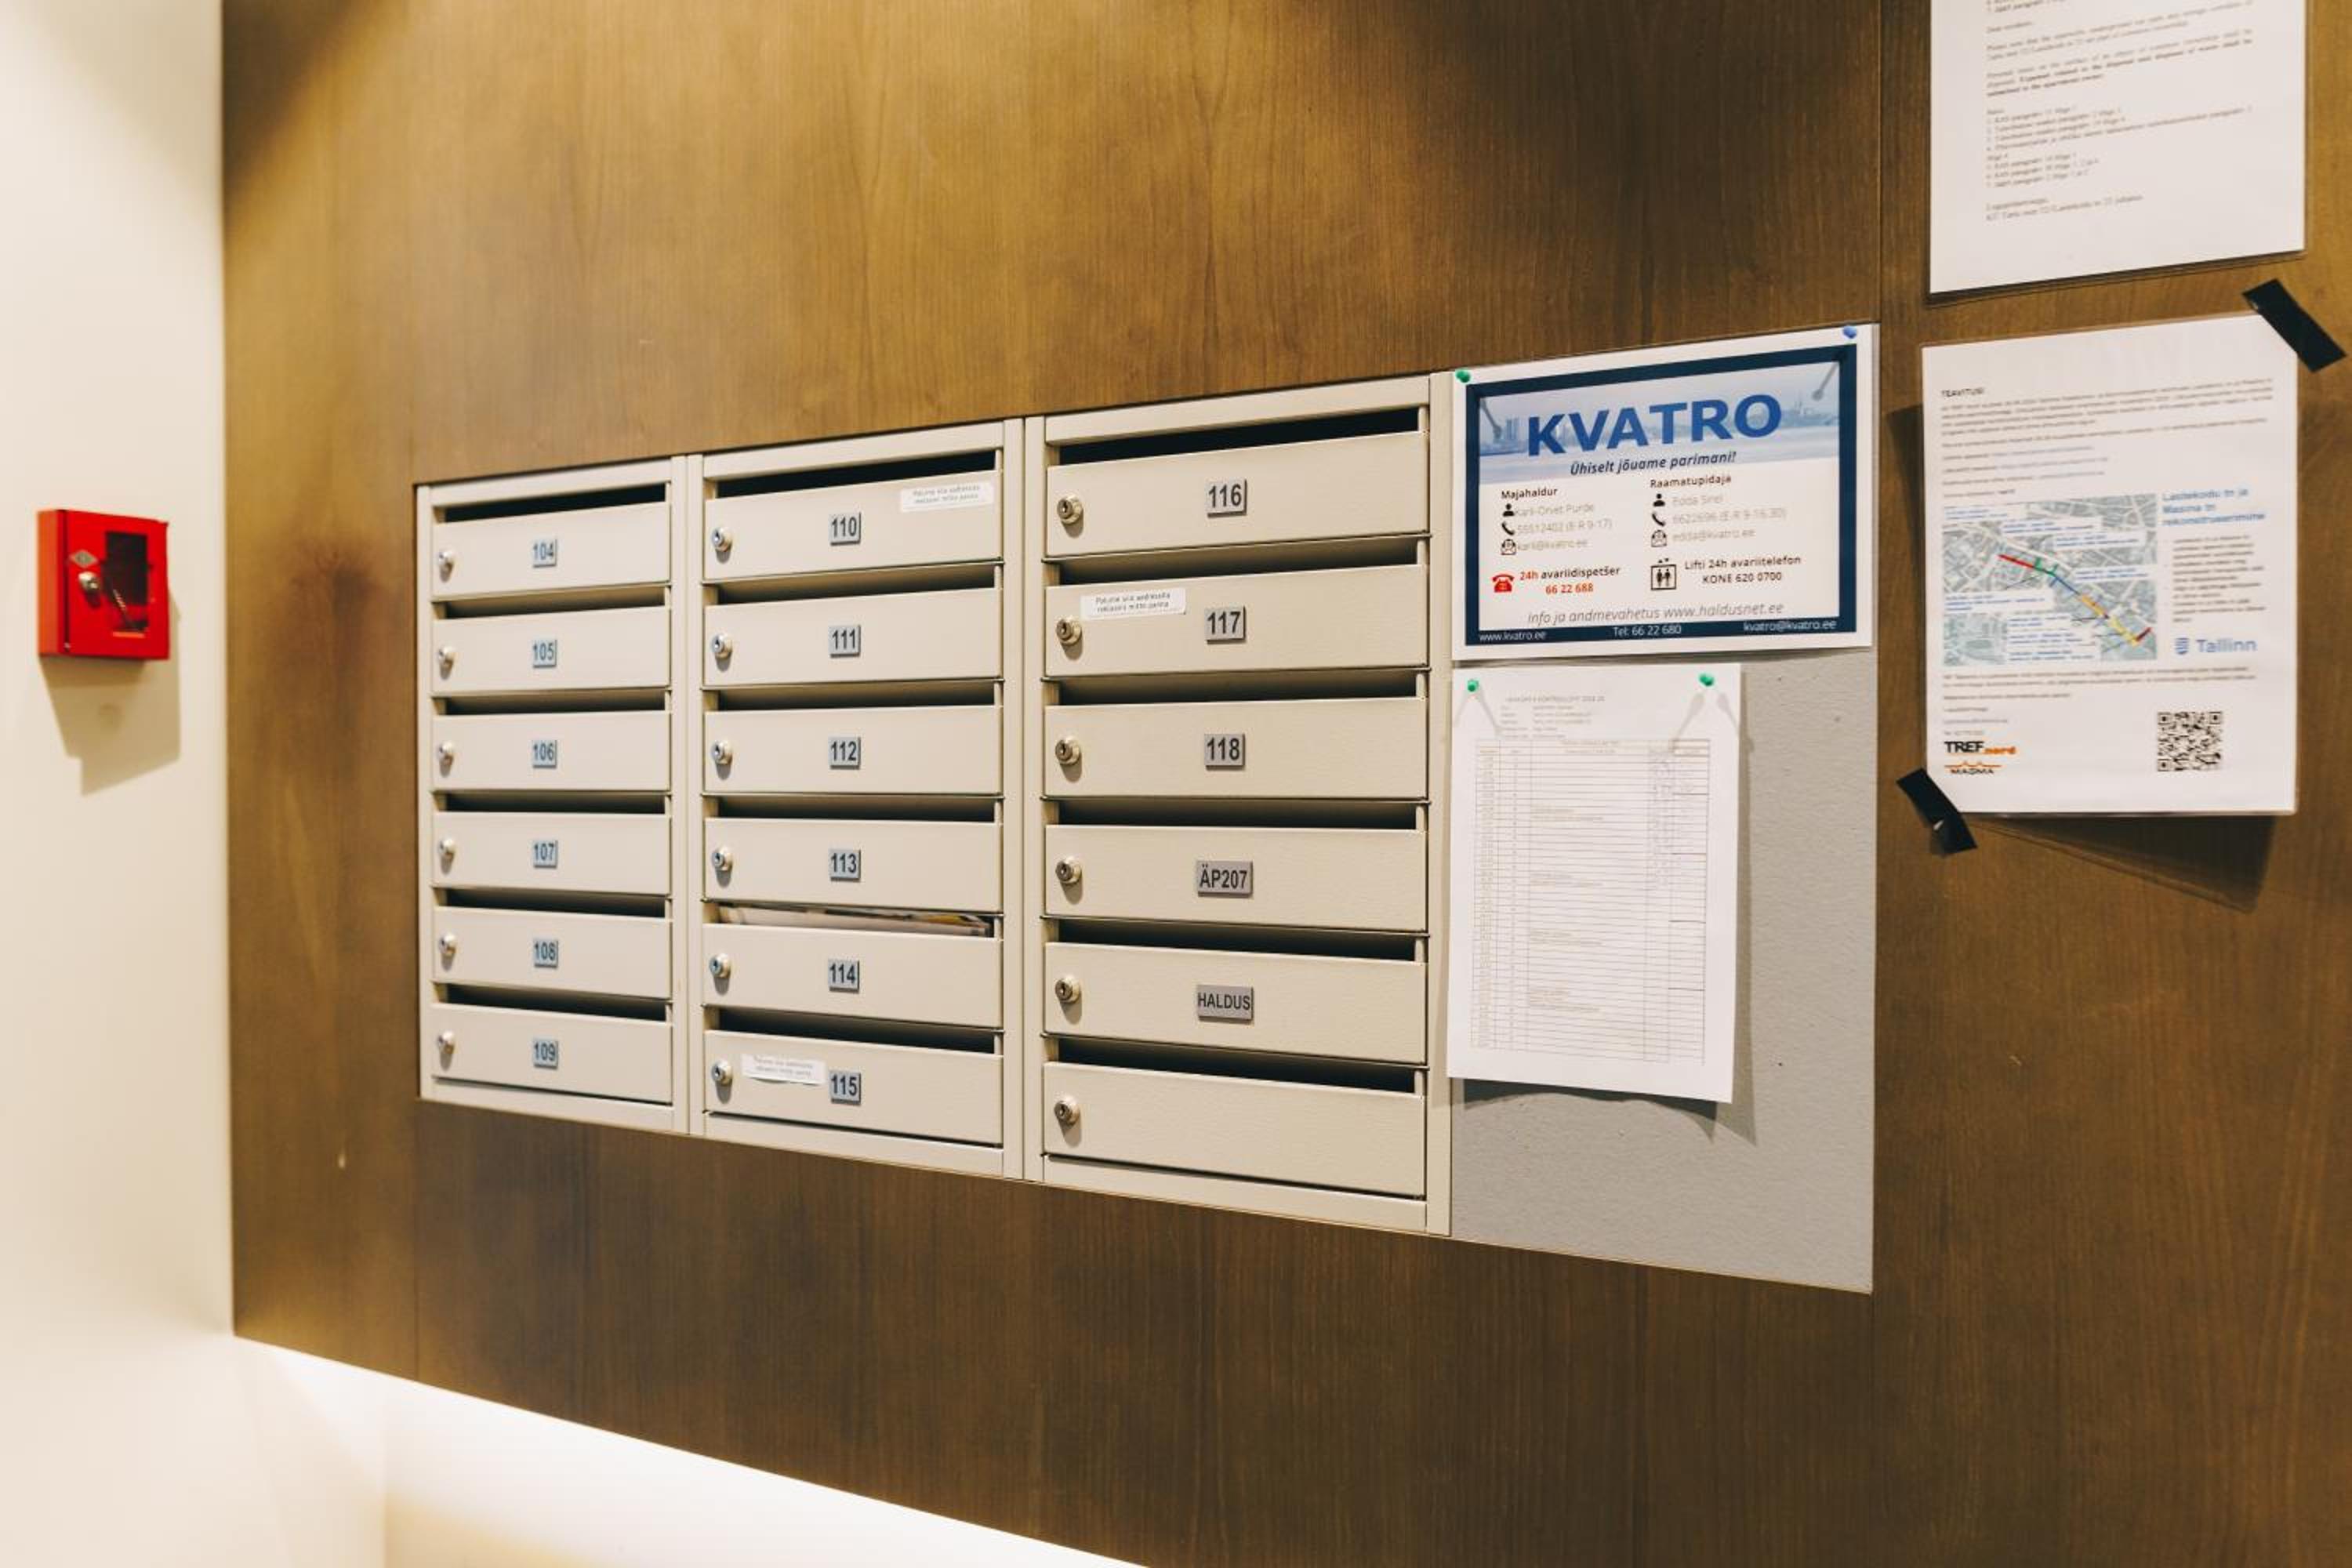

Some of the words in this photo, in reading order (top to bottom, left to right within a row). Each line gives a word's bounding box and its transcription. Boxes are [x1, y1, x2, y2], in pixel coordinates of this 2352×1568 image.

[1528, 394, 1782, 457] KVATRO
[1570, 460, 1614, 476] Ühiselt
[1617, 456, 1666, 473] jõuame
[1669, 451, 1737, 471] parimani!
[1650, 474, 1732, 488] Raamatupidaja
[1207, 484, 1242, 509] 116
[1501, 487, 1558, 500] Majahaldur
[831, 517, 857, 537] 110
[533, 543, 554, 561] 104
[1684, 559, 1706, 571] Lifti
[1708, 558, 1727, 568] 24h
[1730, 555, 1802, 568] avariitelefon
[1519, 571, 1538, 581] 24h
[1703, 573, 1733, 585] KONE
[1735, 573, 1755, 583] 620
[1757, 571, 1783, 582] 0700
[1545, 585, 1558, 595] 66
[1561, 584, 1573, 593] 22
[1575, 583, 1595, 593] 688
[1207, 610, 1241, 635] 117
[1528, 612, 1551, 626] info
[1552, 612, 1566, 626] ja
[1569, 608, 1660, 622] andmevahetus
[1664, 602, 1784, 619] www.haldusnet.ee
[1632, 626, 1645, 636] 66
[1647, 625, 1660, 635] 22
[1662, 624, 1682, 634] 680
[832, 629, 856, 651] 111
[2195, 637, 2257, 653] Tallinn
[533, 643, 554, 661] 105
[533, 742, 554, 761] 106
[829, 740, 857, 762] 112
[1206, 737, 1240, 761] 118
[1944, 741, 1984, 753] TREF
[533, 843, 555, 862] 107
[830, 852, 857, 874] 113
[1200, 863, 1248, 889] ÄP207
[533, 942, 556, 961] 108
[829, 963, 856, 985] 114
[1197, 992, 1251, 1011] HALDUS
[533, 1041, 556, 1062] 109
[830, 1073, 857, 1097] 115
